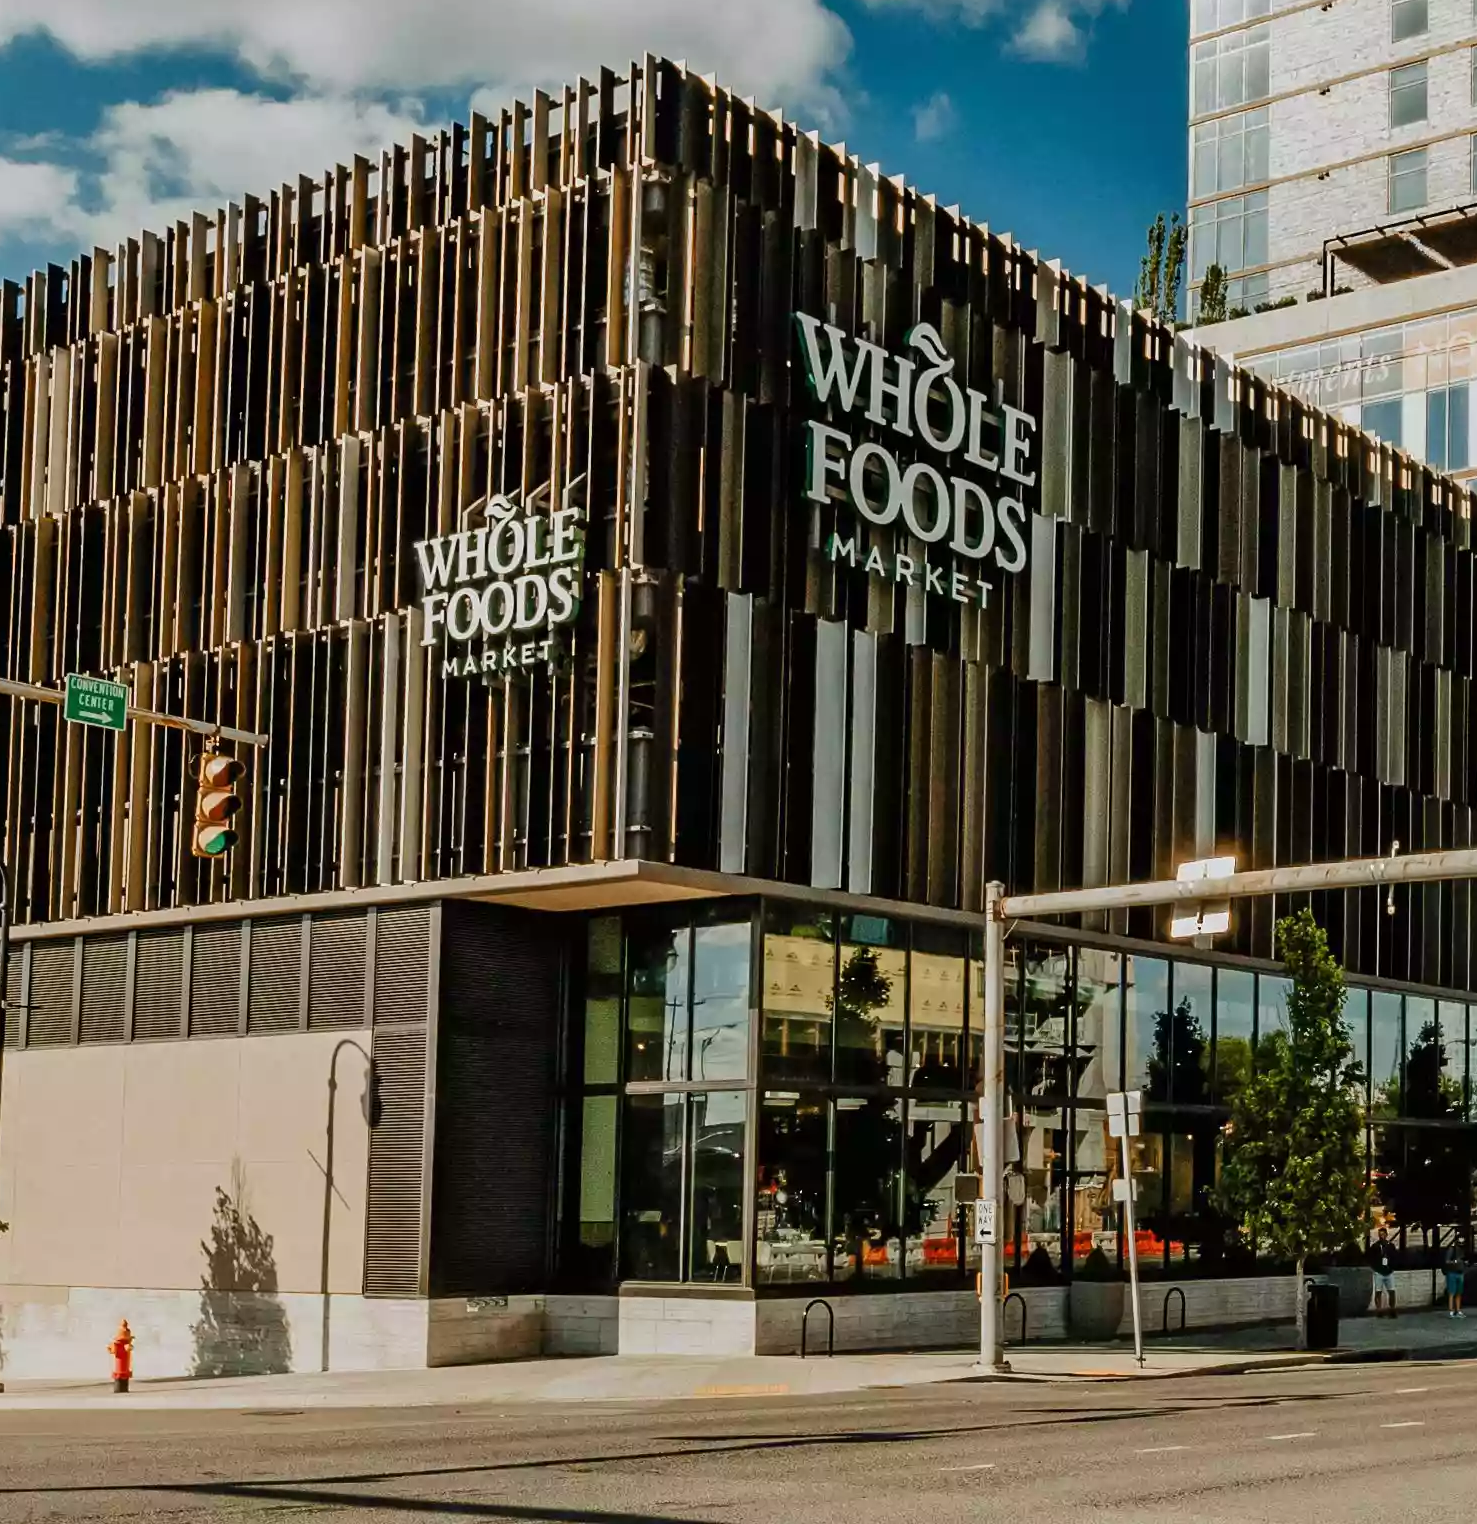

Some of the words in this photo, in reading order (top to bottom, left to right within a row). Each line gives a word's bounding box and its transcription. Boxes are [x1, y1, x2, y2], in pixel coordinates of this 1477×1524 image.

[795, 311, 1036, 487] WHOLE
[806, 419, 1027, 574] FOODS
[412, 493, 584, 590] WHOLE
[830, 531, 993, 609] MARKET
[419, 566, 578, 648] FOODS
[70, 676, 124, 699] CONVENTION
[441, 640, 554, 679] MARKET
[78, 692, 114, 711] CENTER
[978, 1203, 993, 1214] ONE
[978, 1215, 993, 1225] WAY
